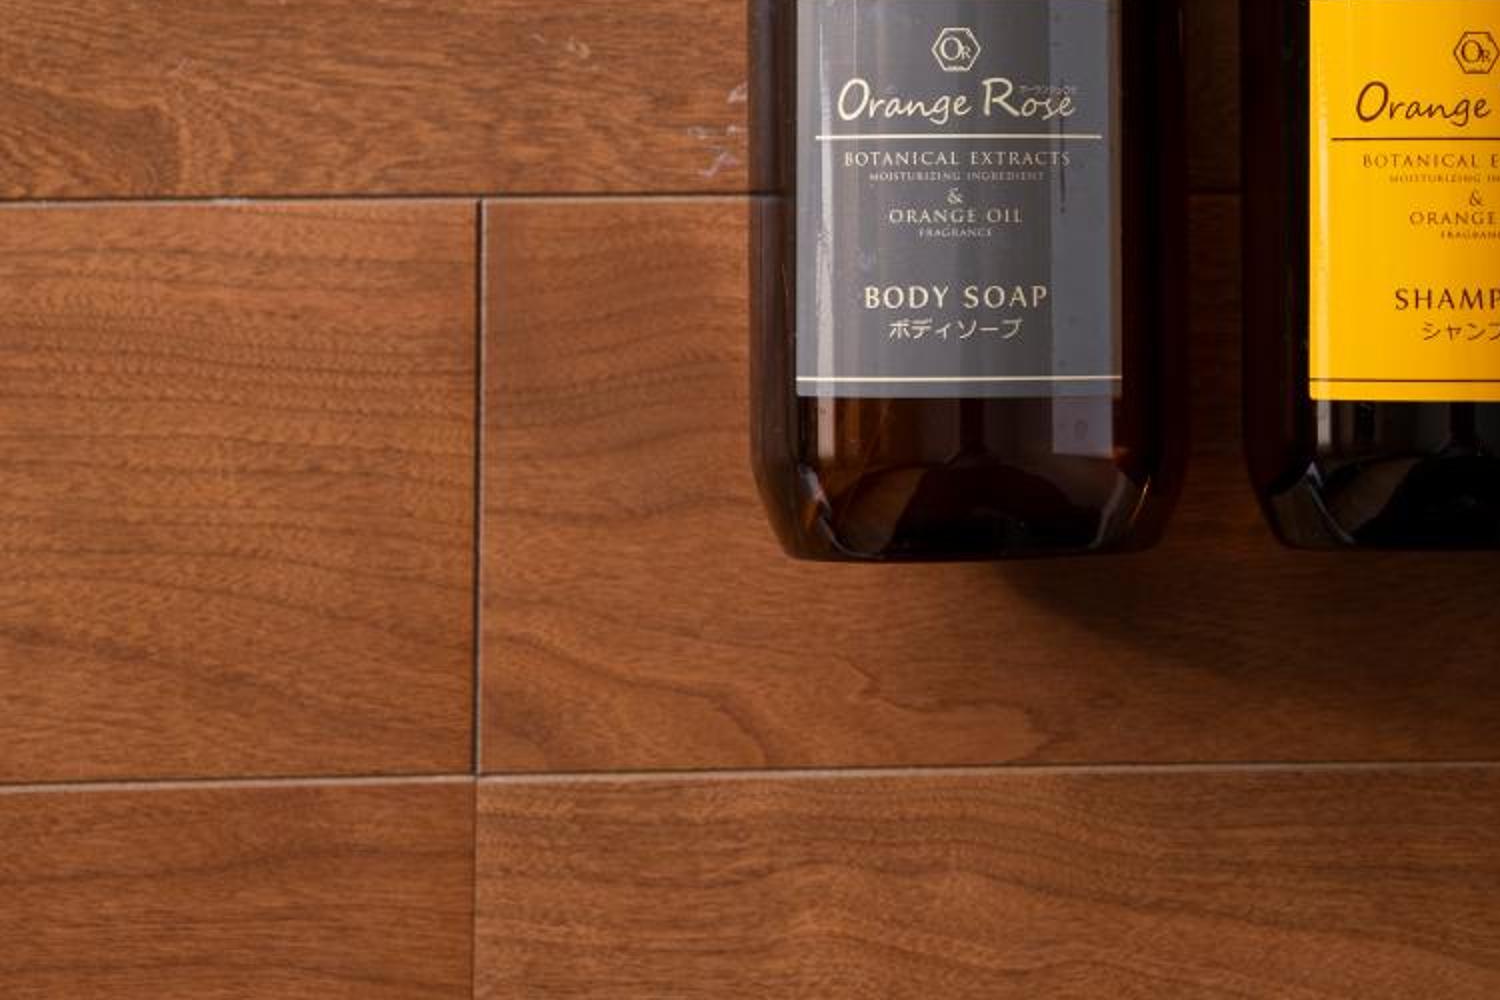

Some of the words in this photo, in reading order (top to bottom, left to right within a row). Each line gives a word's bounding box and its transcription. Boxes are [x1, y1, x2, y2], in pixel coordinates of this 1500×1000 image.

[838, 78, 972, 125] Orange
[982, 78, 1076, 120] Rose
[1356, 81, 1491, 127] Orange
[845, 152, 959, 166] BOTANICAL
[971, 152, 1070, 166] EXTRACTS
[1363, 154, 1478, 168] BOTANICAL
[870, 173, 960, 181] MOISTURIZING
[947, 188, 963, 203] &
[1469, 191, 1482, 205] &
[889, 209, 976, 223] ORANGE
[987, 209, 1023, 223] OIL
[1410, 212, 1495, 225] ORANGE
[919, 228, 992, 237] FRAGRANCE
[865, 286, 949, 309] BODY
[963, 285, 1047, 308] SOAP
